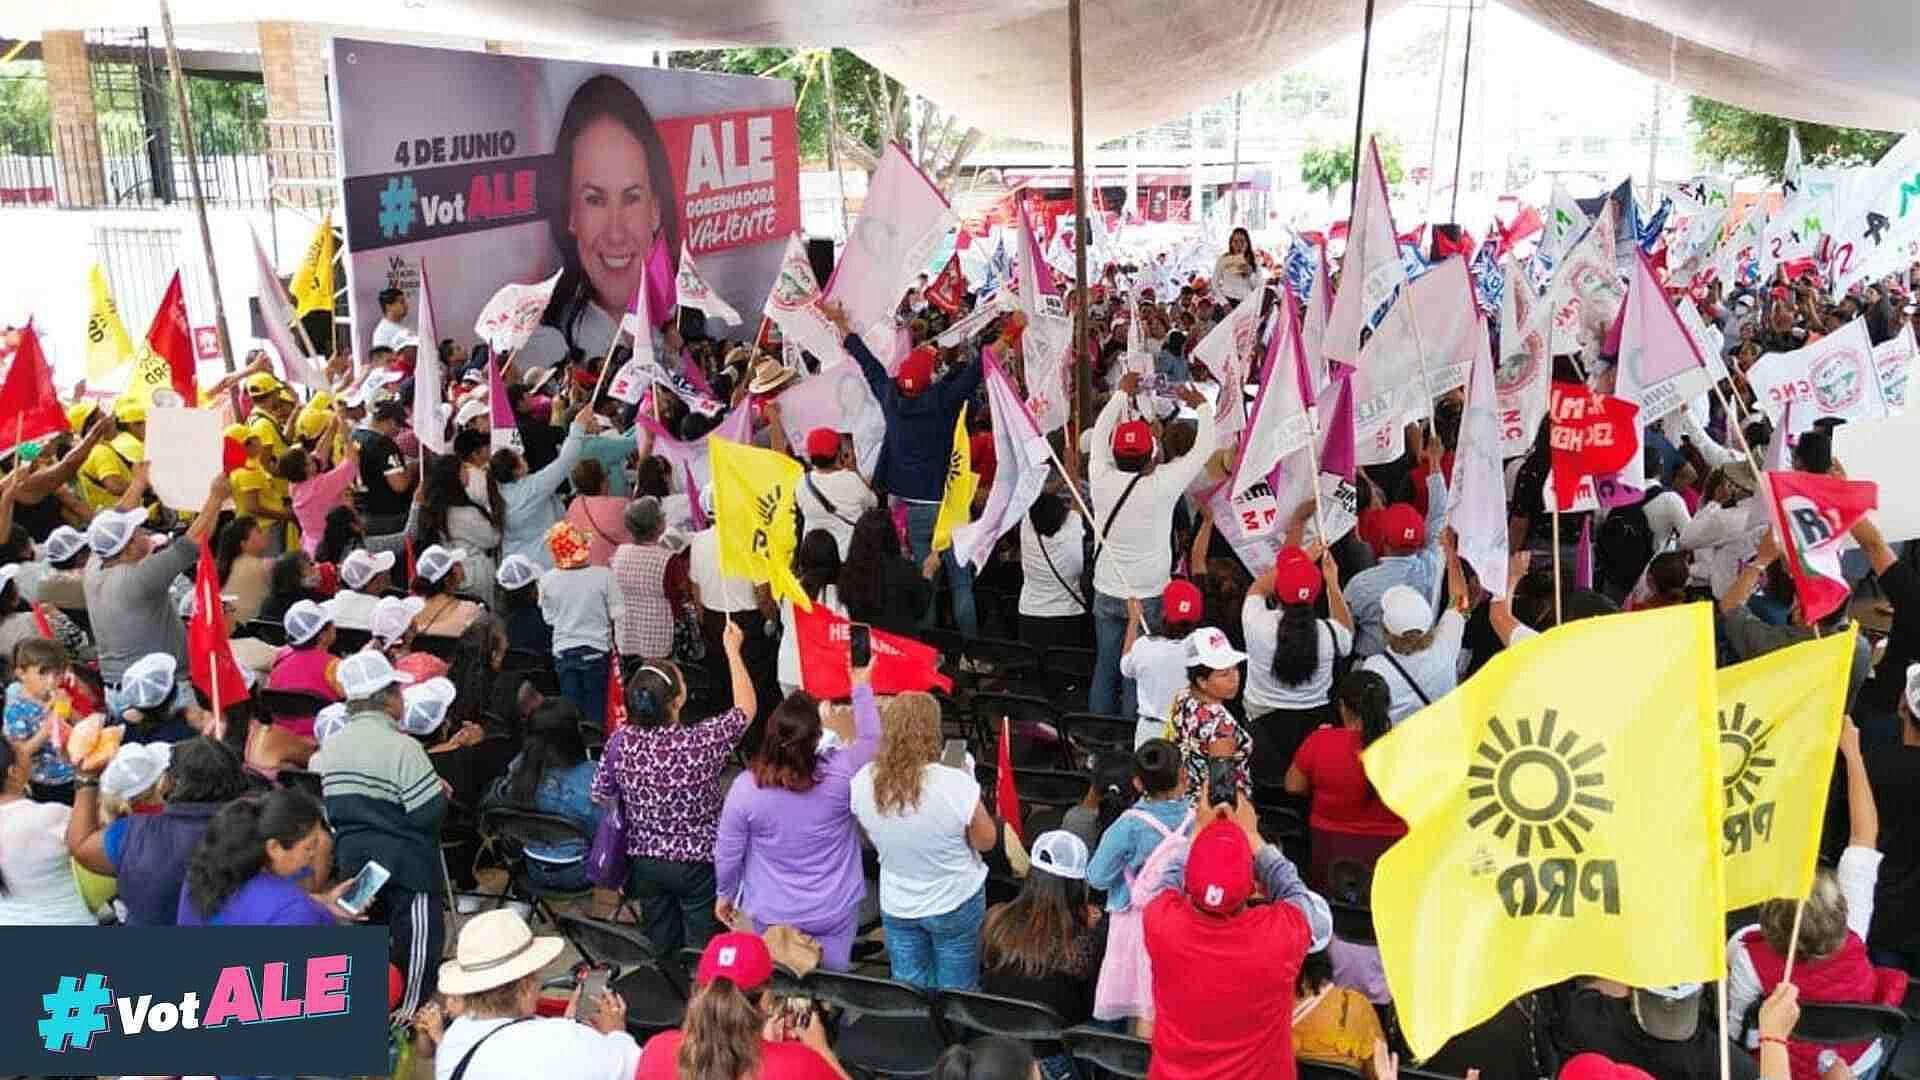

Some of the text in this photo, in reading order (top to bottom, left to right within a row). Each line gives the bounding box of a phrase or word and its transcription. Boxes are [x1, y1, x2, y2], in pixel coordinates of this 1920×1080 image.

[394, 129, 516, 167] 4 DE JUNIO
[685, 116, 775, 195] ALE
[686, 185, 776, 219] GOBERNADORA
[688, 206, 776, 251] VALIENTE
